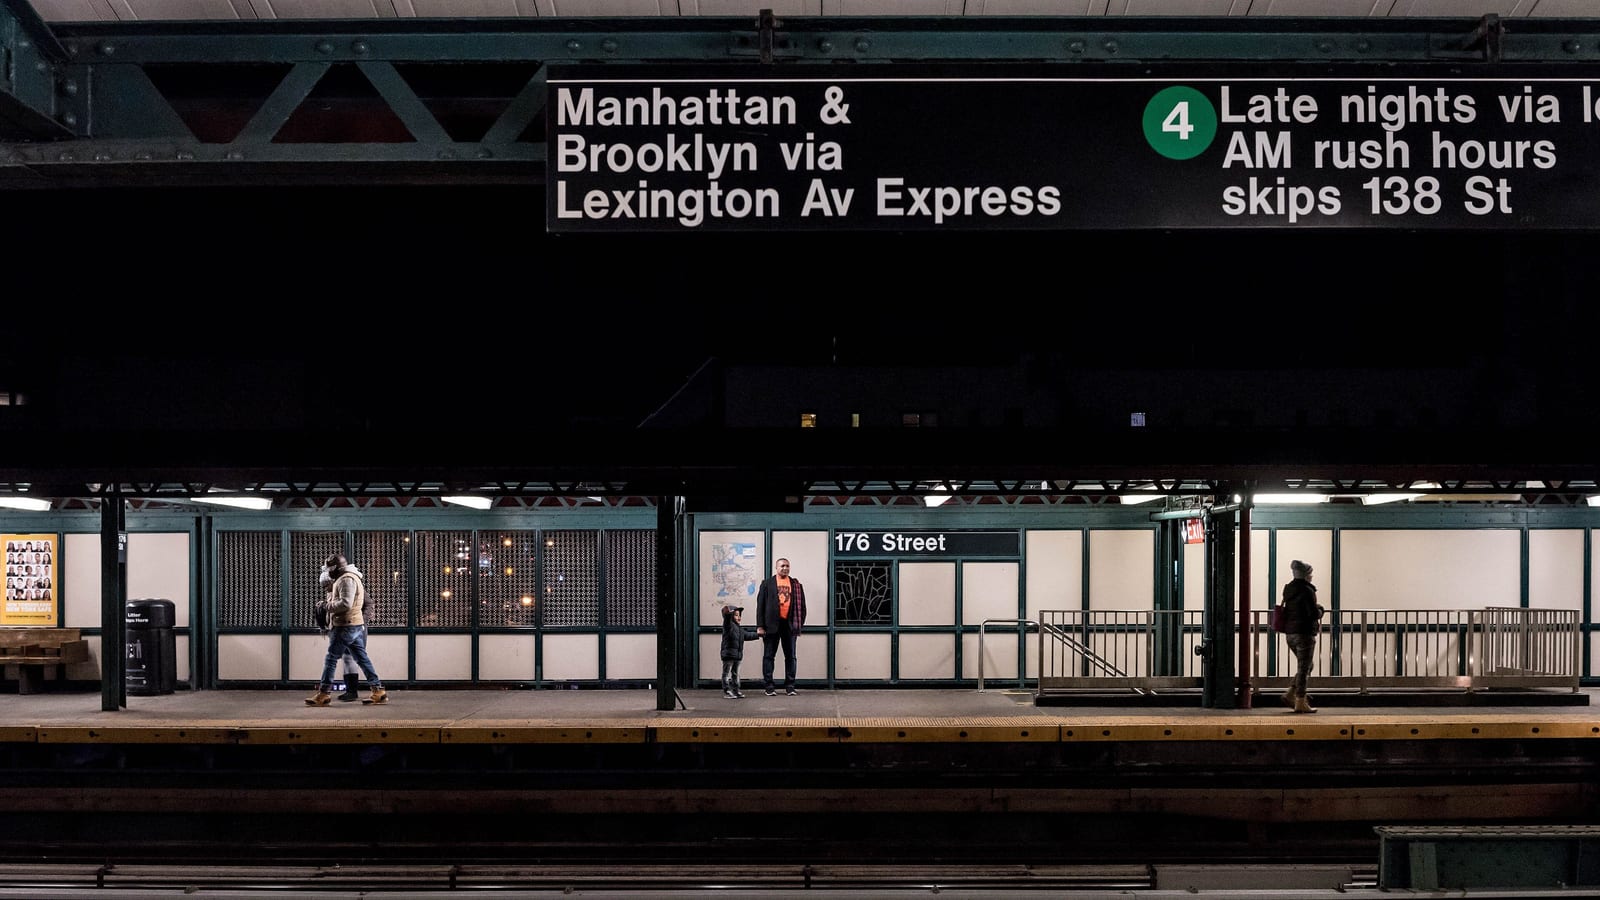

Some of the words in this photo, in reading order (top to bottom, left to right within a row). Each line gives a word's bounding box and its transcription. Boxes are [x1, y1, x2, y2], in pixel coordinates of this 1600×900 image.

[557, 87, 796, 126] Manhattan
[819, 85, 852, 125] &
[1161, 101, 1195, 140] 4
[1221, 85, 1318, 123] Late
[1341, 85, 1477, 131] nights
[1498, 85, 1561, 123] via
[557, 133, 757, 179] Brooklyn
[779, 132, 843, 171] via
[1222, 130, 1292, 169] AM
[1314, 130, 1410, 169] rush
[1432, 130, 1557, 169] hours
[557, 180, 780, 227] Lexington
[800, 178, 855, 217] Av
[877, 177, 1062, 224] Express
[1222, 176, 1342, 223] skips
[1362, 175, 1442, 215] 138
[1464, 175, 1513, 215] St
[834, 533, 870, 551] 176
[882, 533, 946, 551] Street
